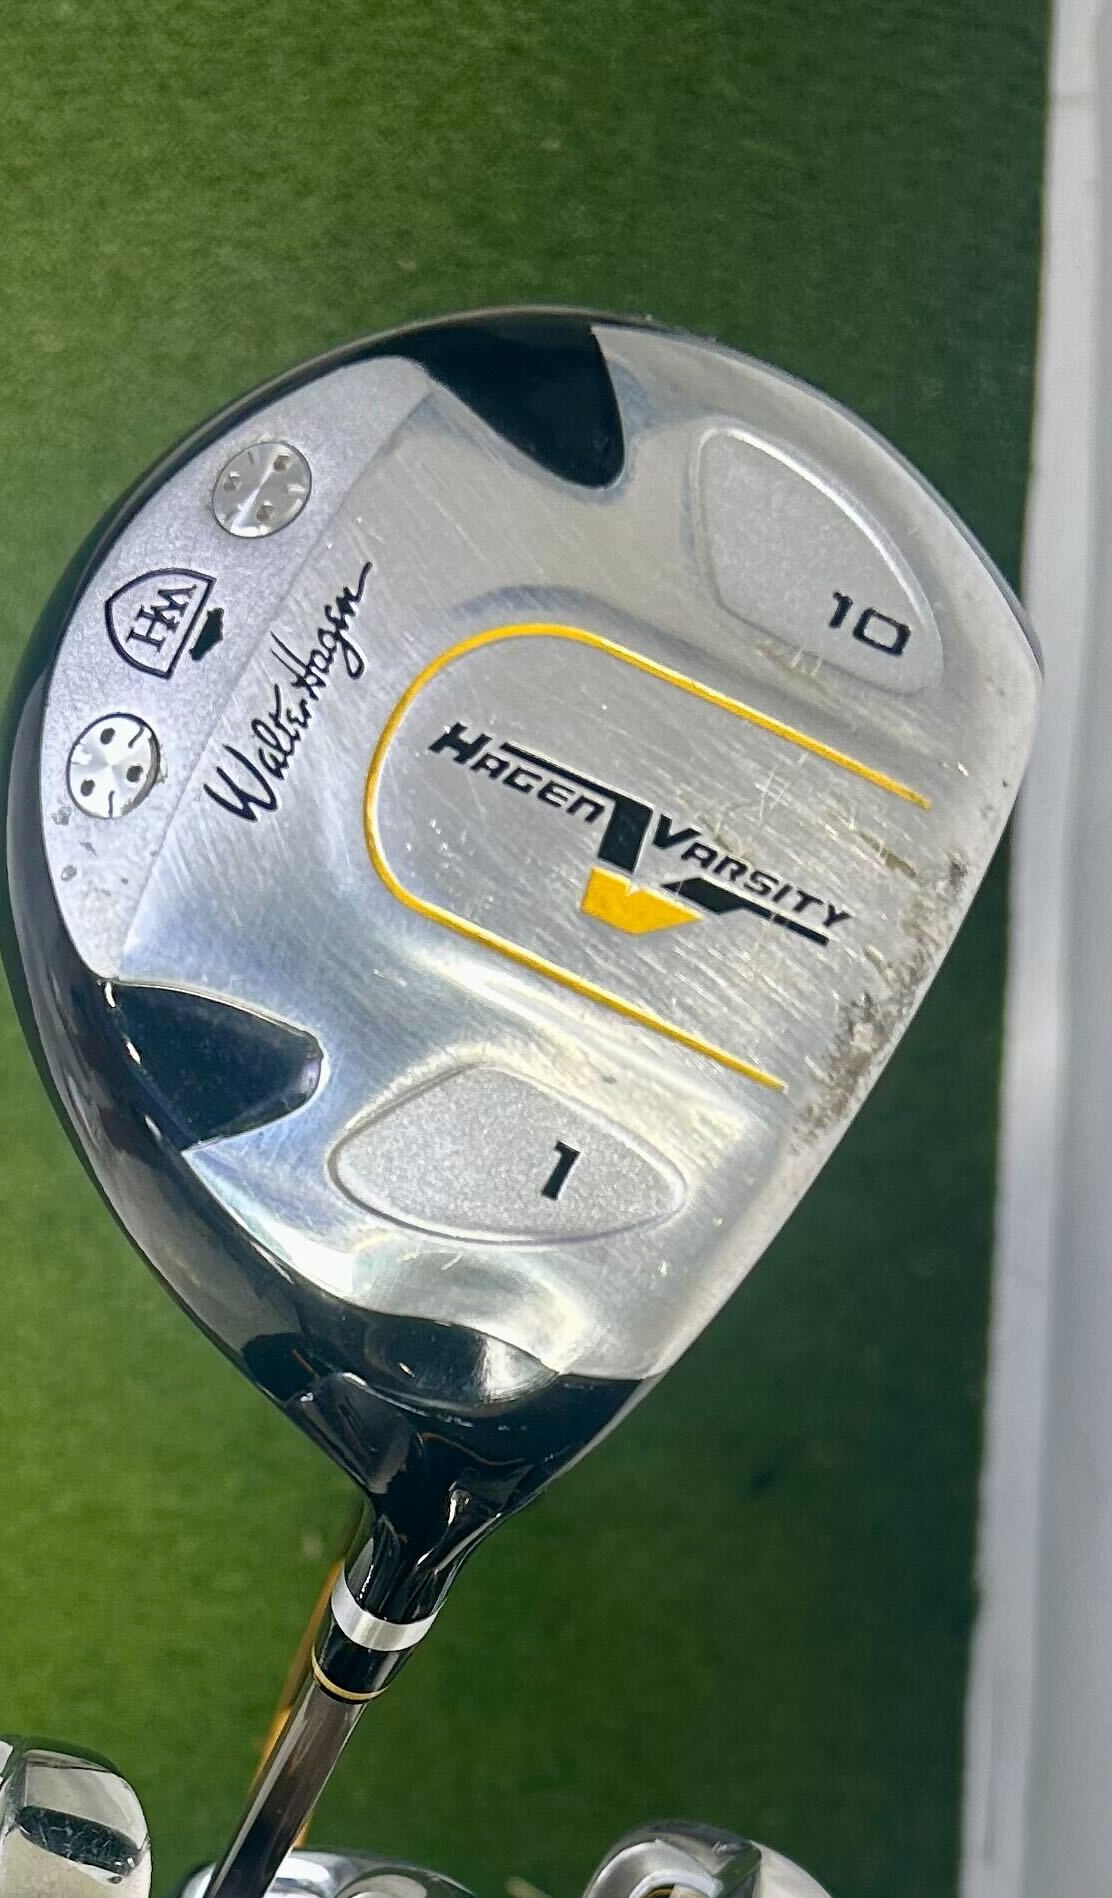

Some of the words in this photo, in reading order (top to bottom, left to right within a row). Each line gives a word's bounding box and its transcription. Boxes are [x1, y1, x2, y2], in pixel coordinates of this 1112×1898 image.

[830, 590, 911, 659] 10
[202, 683, 312, 822] Walter
[541, 1140, 580, 1200] 1
